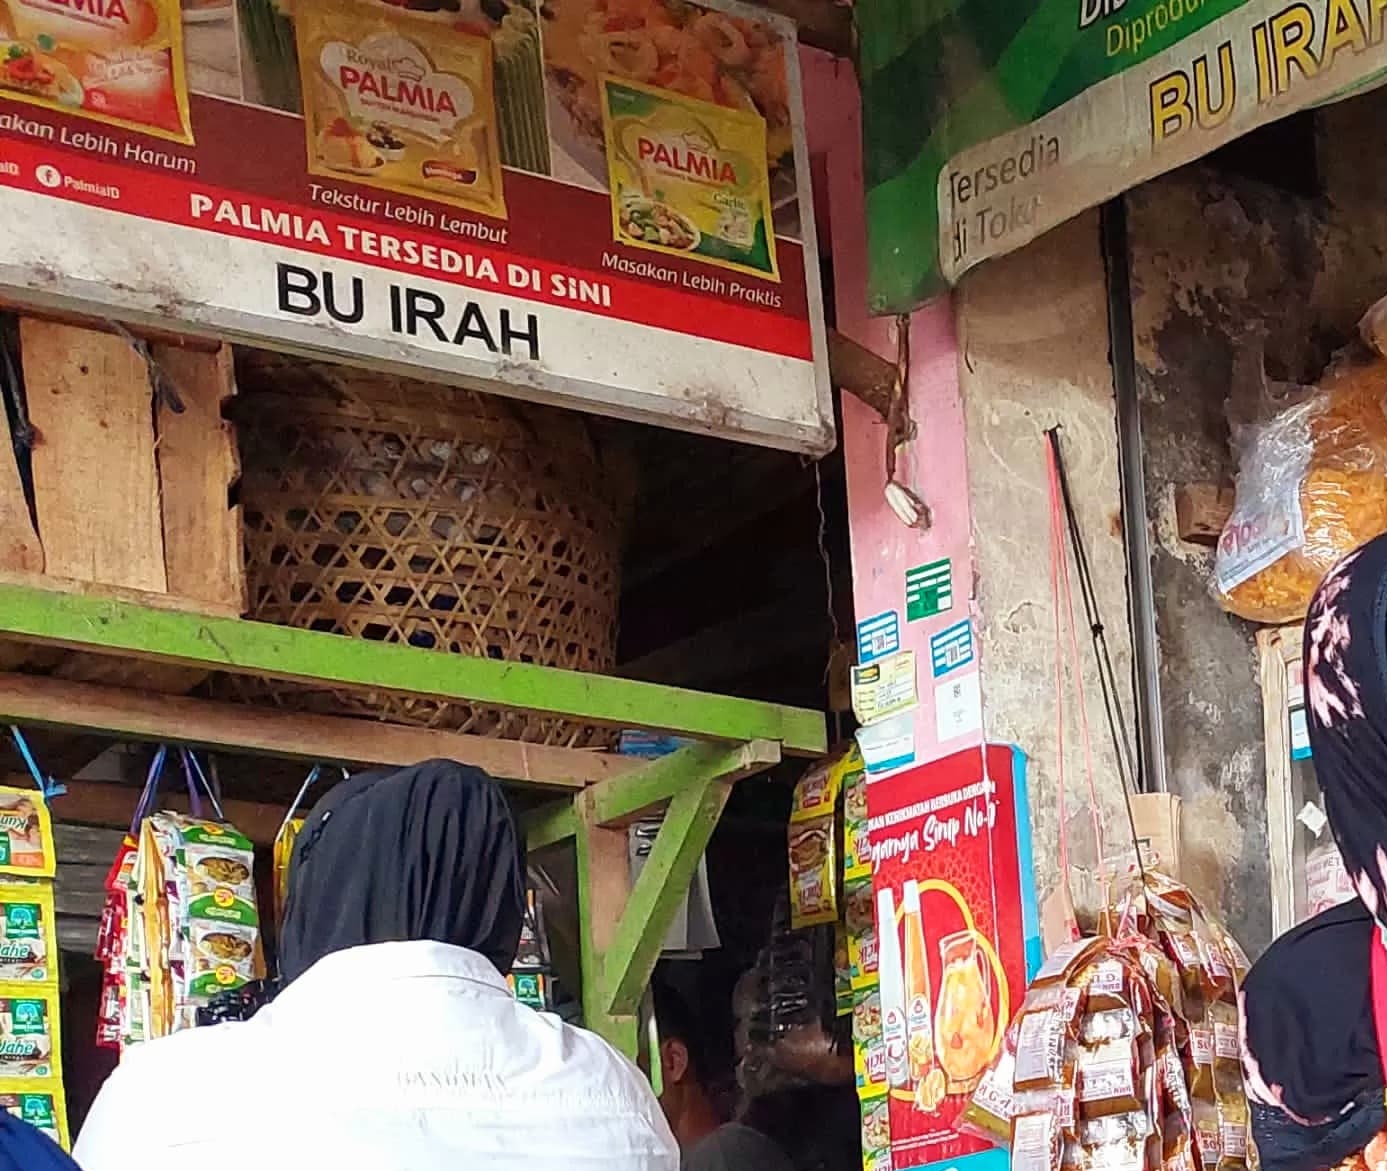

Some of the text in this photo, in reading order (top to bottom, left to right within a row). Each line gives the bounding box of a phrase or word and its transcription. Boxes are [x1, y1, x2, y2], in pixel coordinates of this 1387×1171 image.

[347, 50, 391, 71] Royal
[340, 65, 457, 117] PALMIA
[1149, 40, 1236, 147] BU
[60, 127, 118, 155] Lebih
[125, 144, 197, 175] Harum
[637, 136, 737, 184] PALMIA
[949, 132, 1060, 218] Tersedia
[64, 175, 120, 200] PalmiaID
[308, 184, 508, 244] Tekstur Lebih Lembut
[190, 193, 331, 246] PALMIA
[337, 224, 498, 282] TERSEDIA
[507, 263, 541, 292] DI
[602, 252, 782, 308] Masakan Lebih Praktis
[277, 263, 541, 361] BU IRAH
